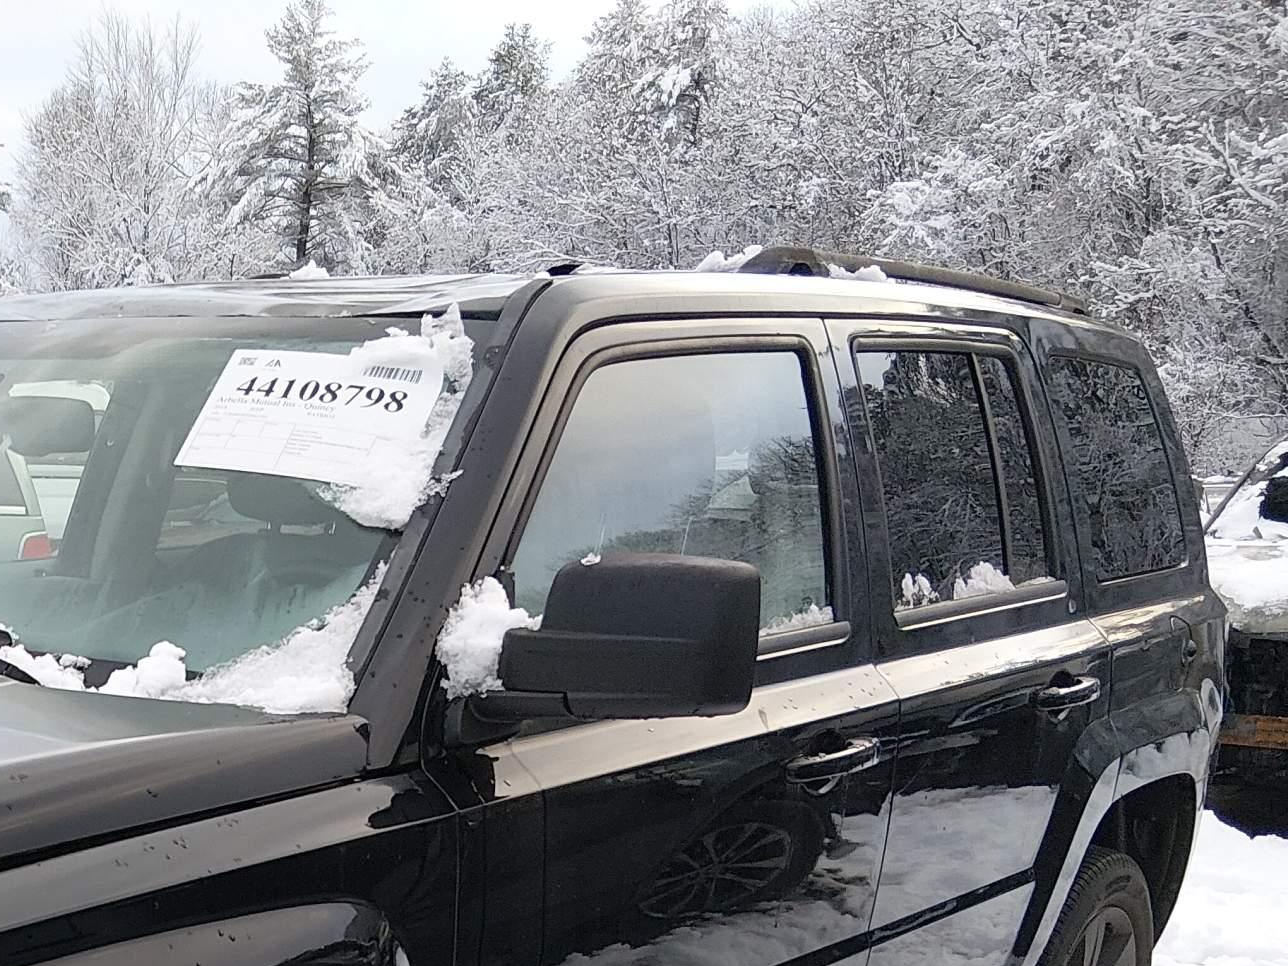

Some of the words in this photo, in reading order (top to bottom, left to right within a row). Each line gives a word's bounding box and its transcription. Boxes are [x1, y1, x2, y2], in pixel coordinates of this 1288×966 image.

[236, 376, 408, 413] 44108798
[251, 397, 281, 407] Mutual
[304, 402, 337, 413] Quincy
